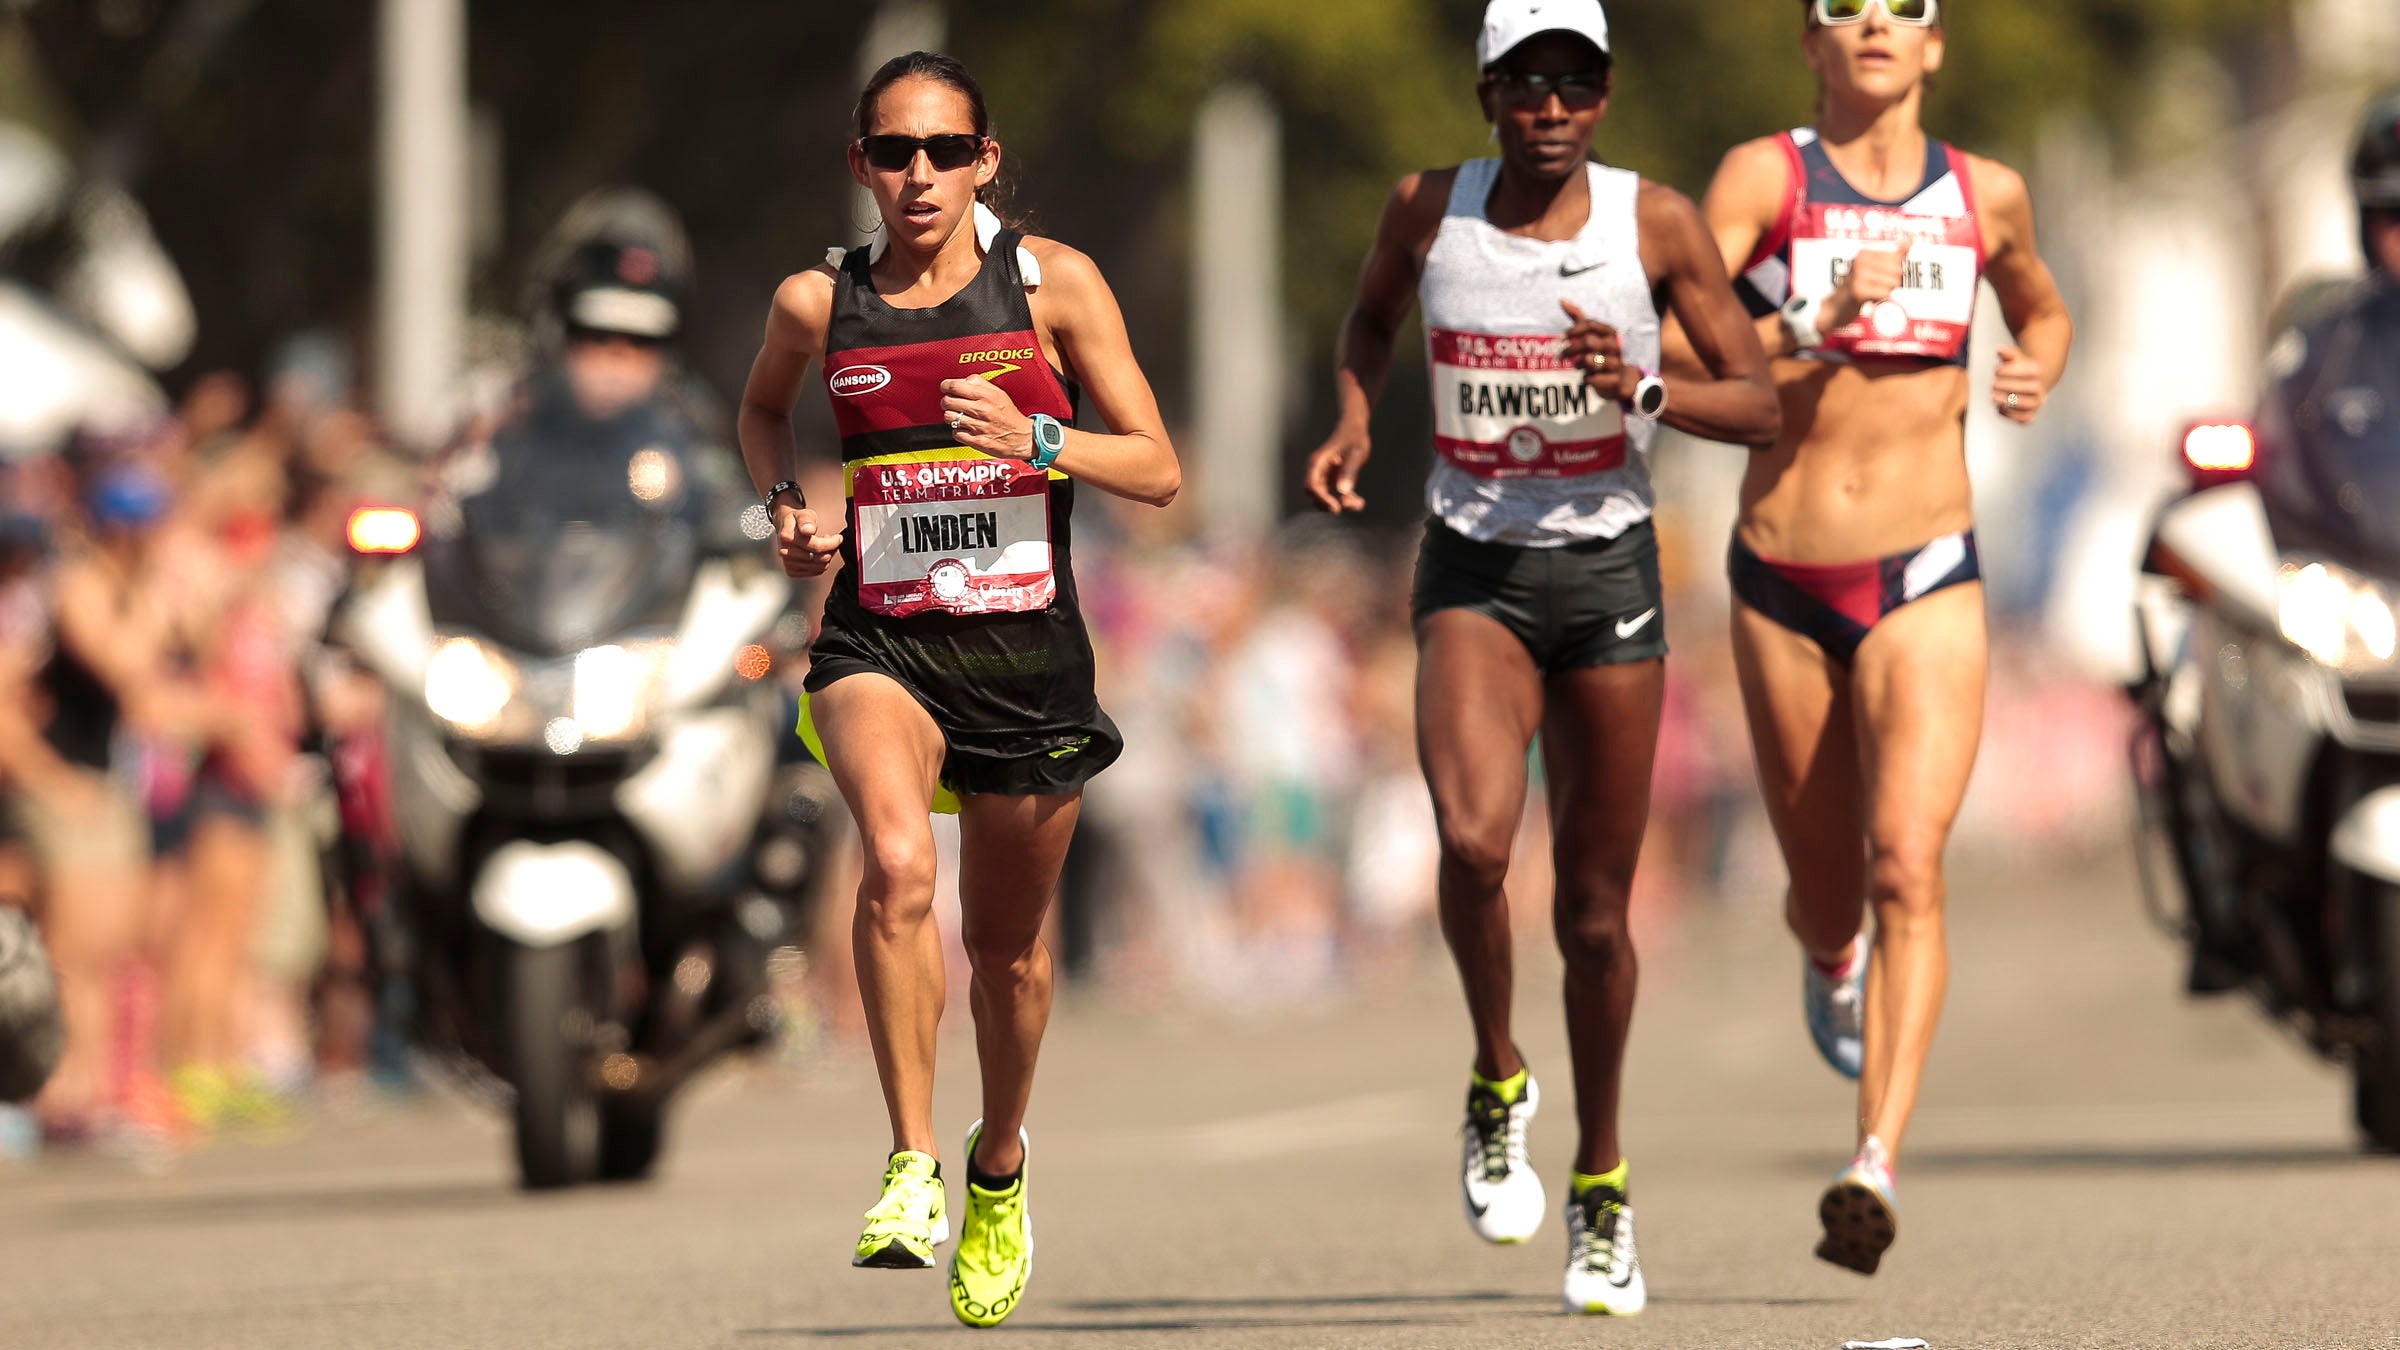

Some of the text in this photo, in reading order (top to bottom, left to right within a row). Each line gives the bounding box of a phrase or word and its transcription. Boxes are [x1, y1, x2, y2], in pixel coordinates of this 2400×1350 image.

[1830, 257, 1944, 290] GHER
[958, 348, 1034, 364] BROOKS
[1517, 356, 1572, 370] TRIAL
[833, 372, 884, 388] HANSONS
[1459, 382, 1588, 417] BAWCOM
[881, 463, 1012, 487] U.S. OLYMPIC
[881, 482, 1011, 501] TEAM TRIALS
[900, 511, 998, 554] LINDEN
